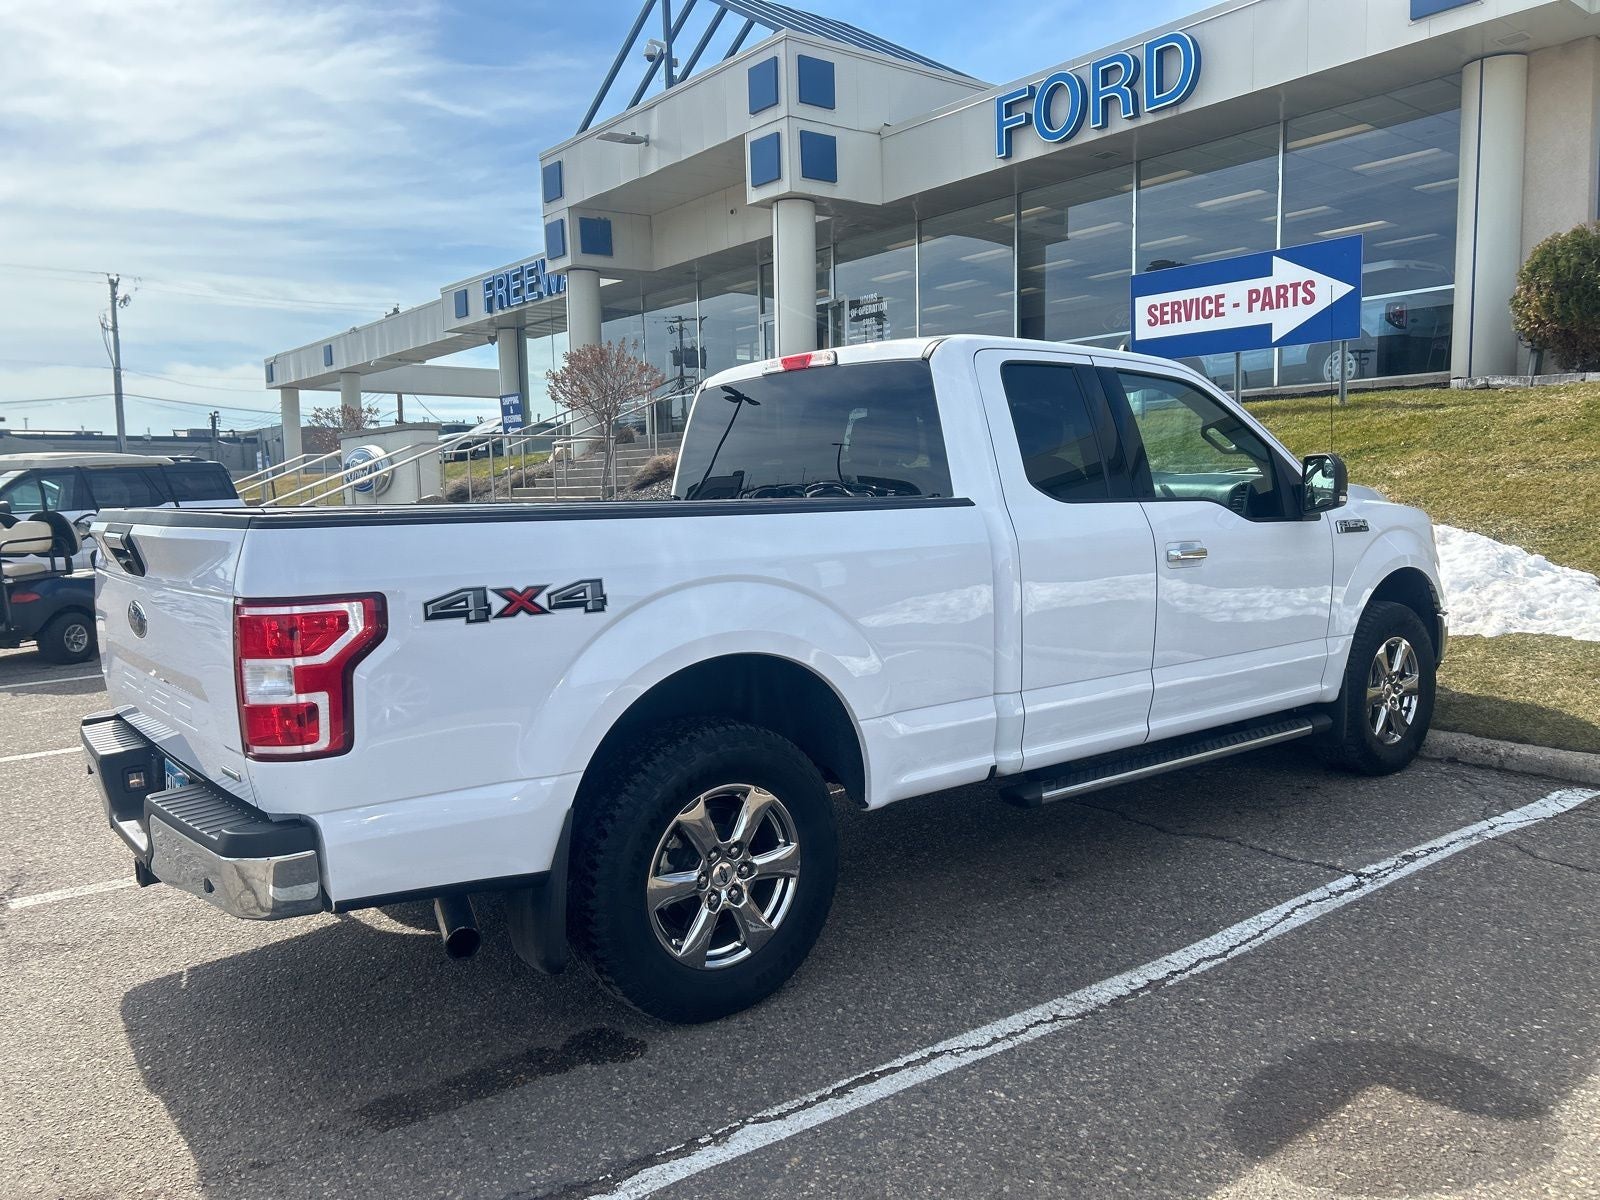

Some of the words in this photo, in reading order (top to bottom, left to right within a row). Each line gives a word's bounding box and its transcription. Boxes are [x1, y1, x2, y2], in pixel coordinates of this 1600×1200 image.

[995, 31, 1201, 159] FORD
[859, 293, 877, 304] HOURS
[1147, 293, 1226, 327] SERVICE
[1247, 279, 1316, 313] PARTS
[850, 308, 858, 317] OF
[858, 300, 888, 315] OPERATION
[862, 317, 876, 325] SALES
[502, 395, 519, 405] SHIPPING
[503, 414, 522, 423] RECEIVING
